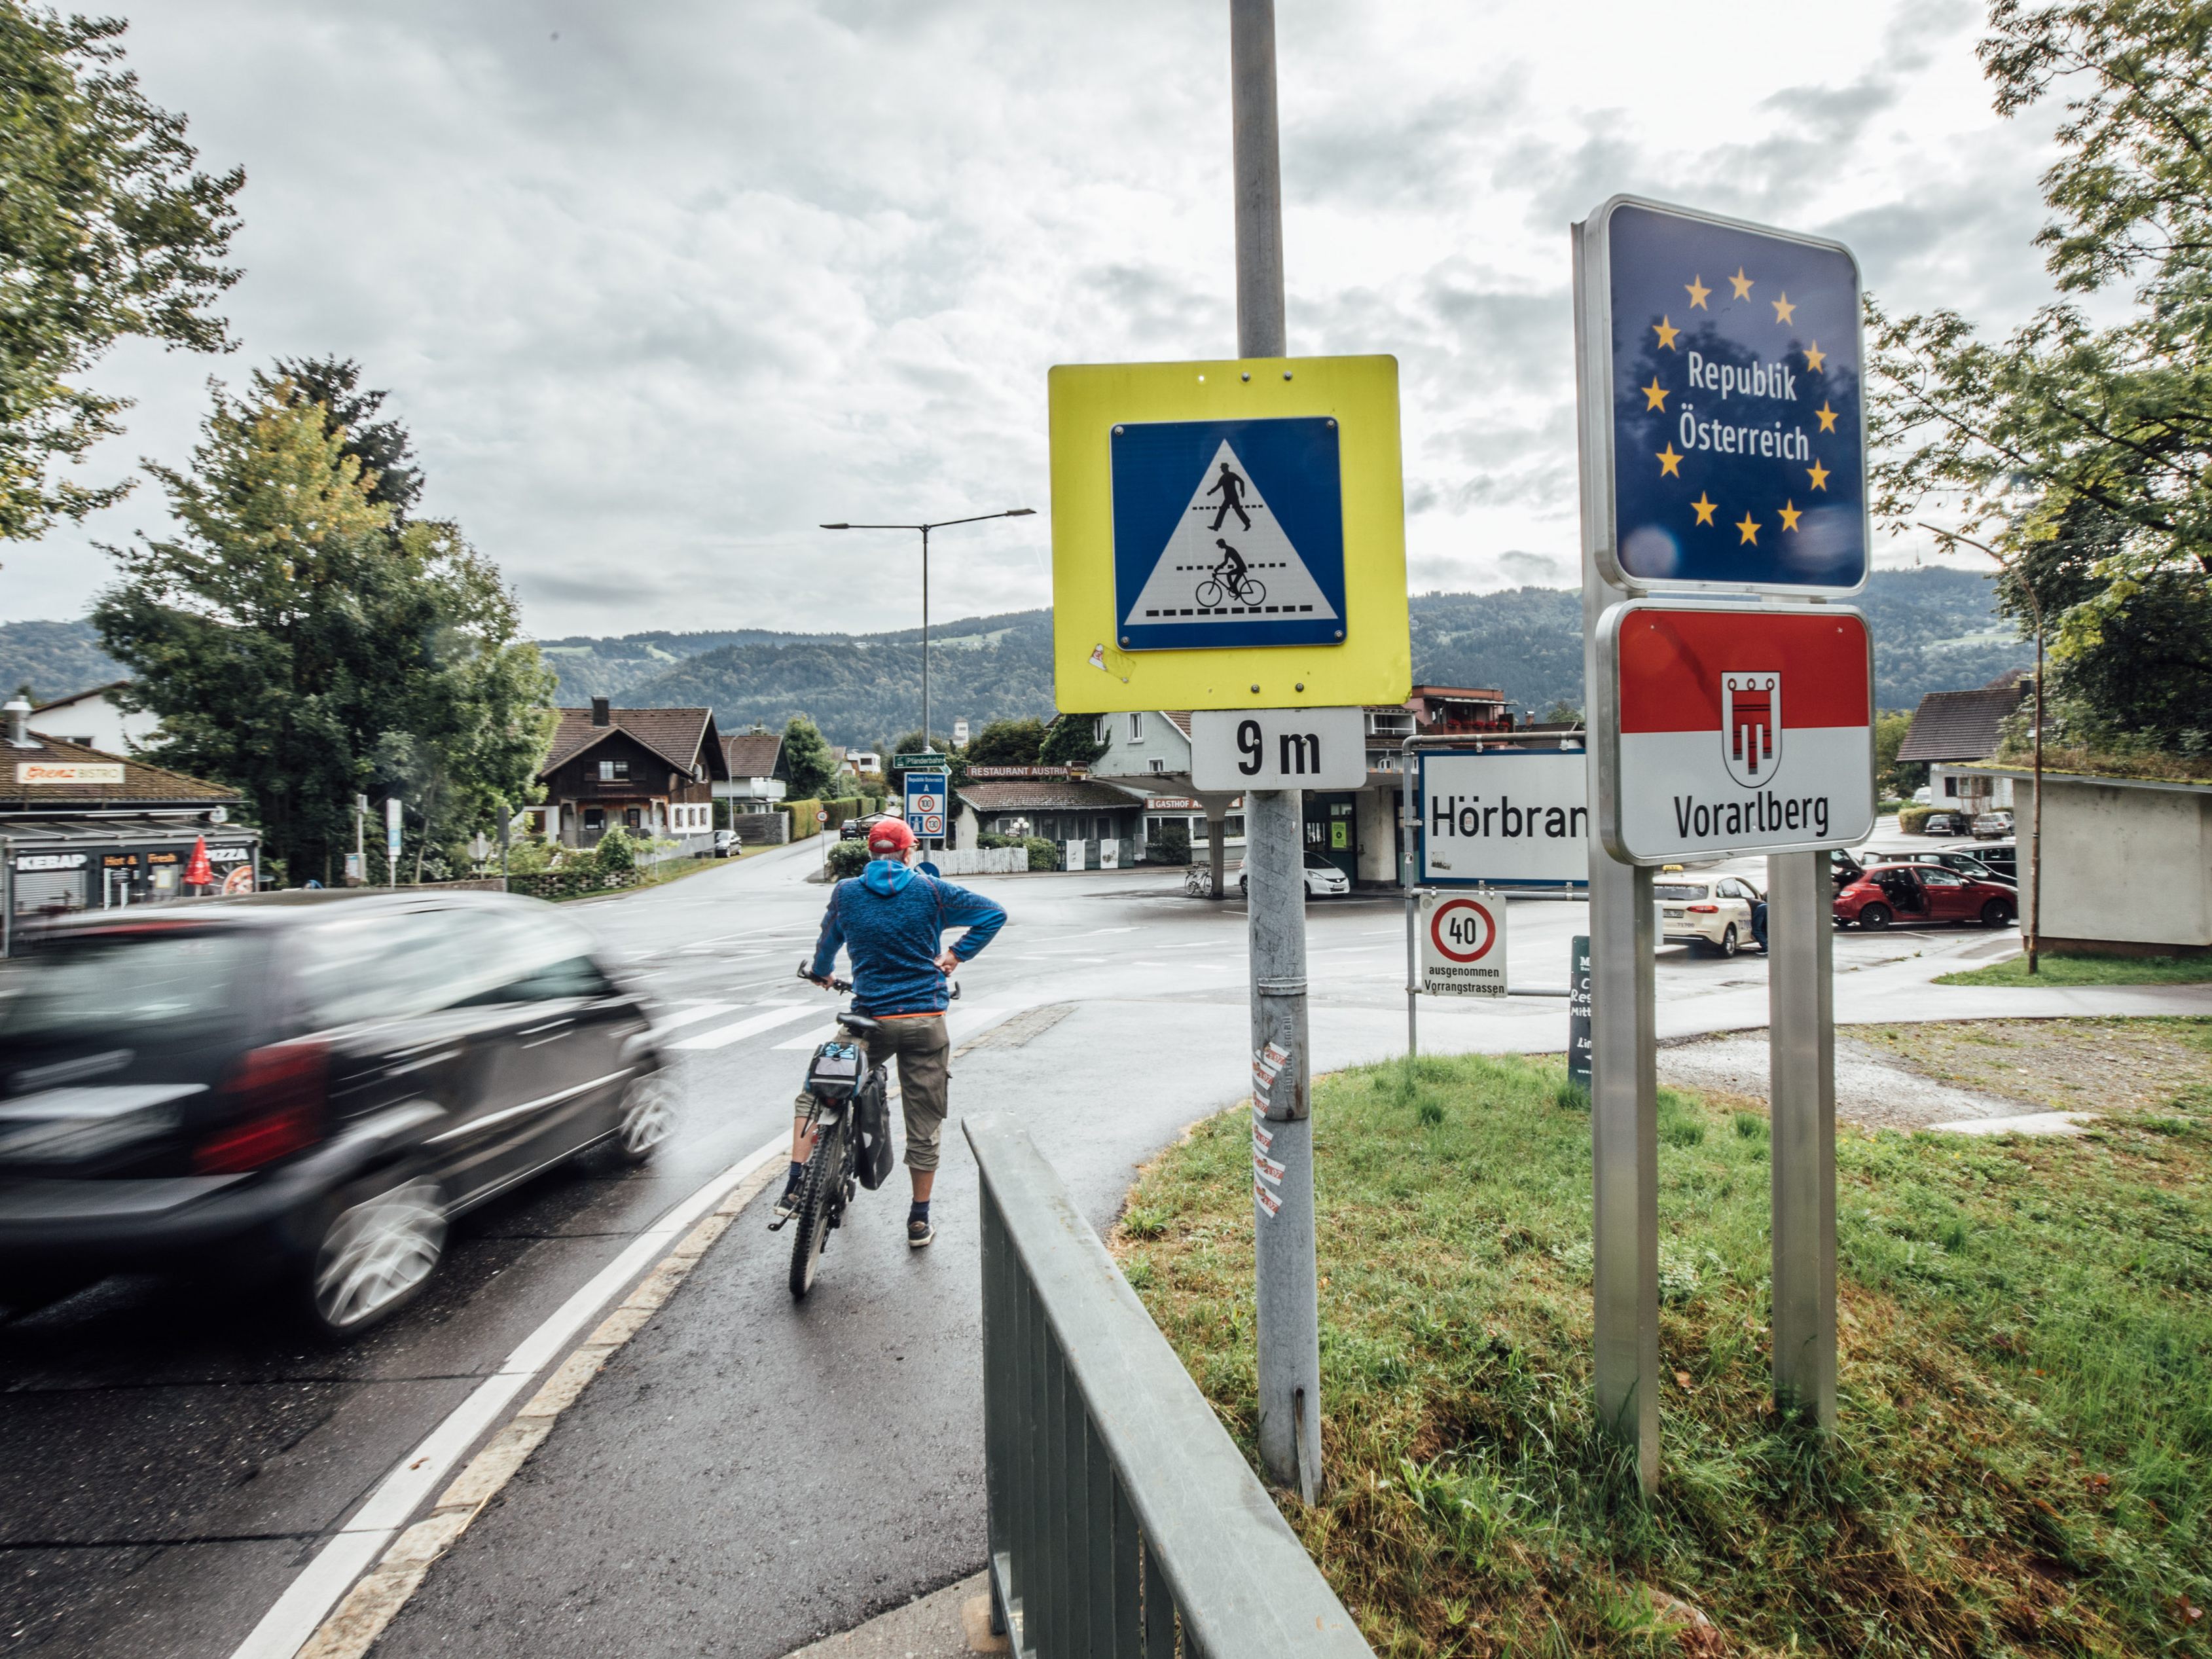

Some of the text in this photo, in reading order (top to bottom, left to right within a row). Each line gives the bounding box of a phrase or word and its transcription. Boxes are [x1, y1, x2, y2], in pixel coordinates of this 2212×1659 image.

[1688, 351, 1798, 401] Republik
[1679, 403, 1809, 461] Österreich
[1237, 720, 1321, 776] 9 m
[907, 757, 944, 765] Pfänderbahn
[78, 769, 118, 778] BISTRO
[971, 767, 1029, 776] RESTAURANT
[1432, 795, 1589, 838] Hörbran
[1674, 790, 1829, 839] Vorarlberg
[17, 854, 88, 870] KEBAP
[104, 856, 125, 866] Hot
[147, 853, 177, 864] Fresh
[204, 848, 250, 862] PIZZA
[1449, 917, 1476, 945] 40
[1428, 966, 1500, 981] ausgenommen
[1424, 979, 1505, 994] Vorrangstrassen
[1570, 1006, 1591, 1017] Mitt
